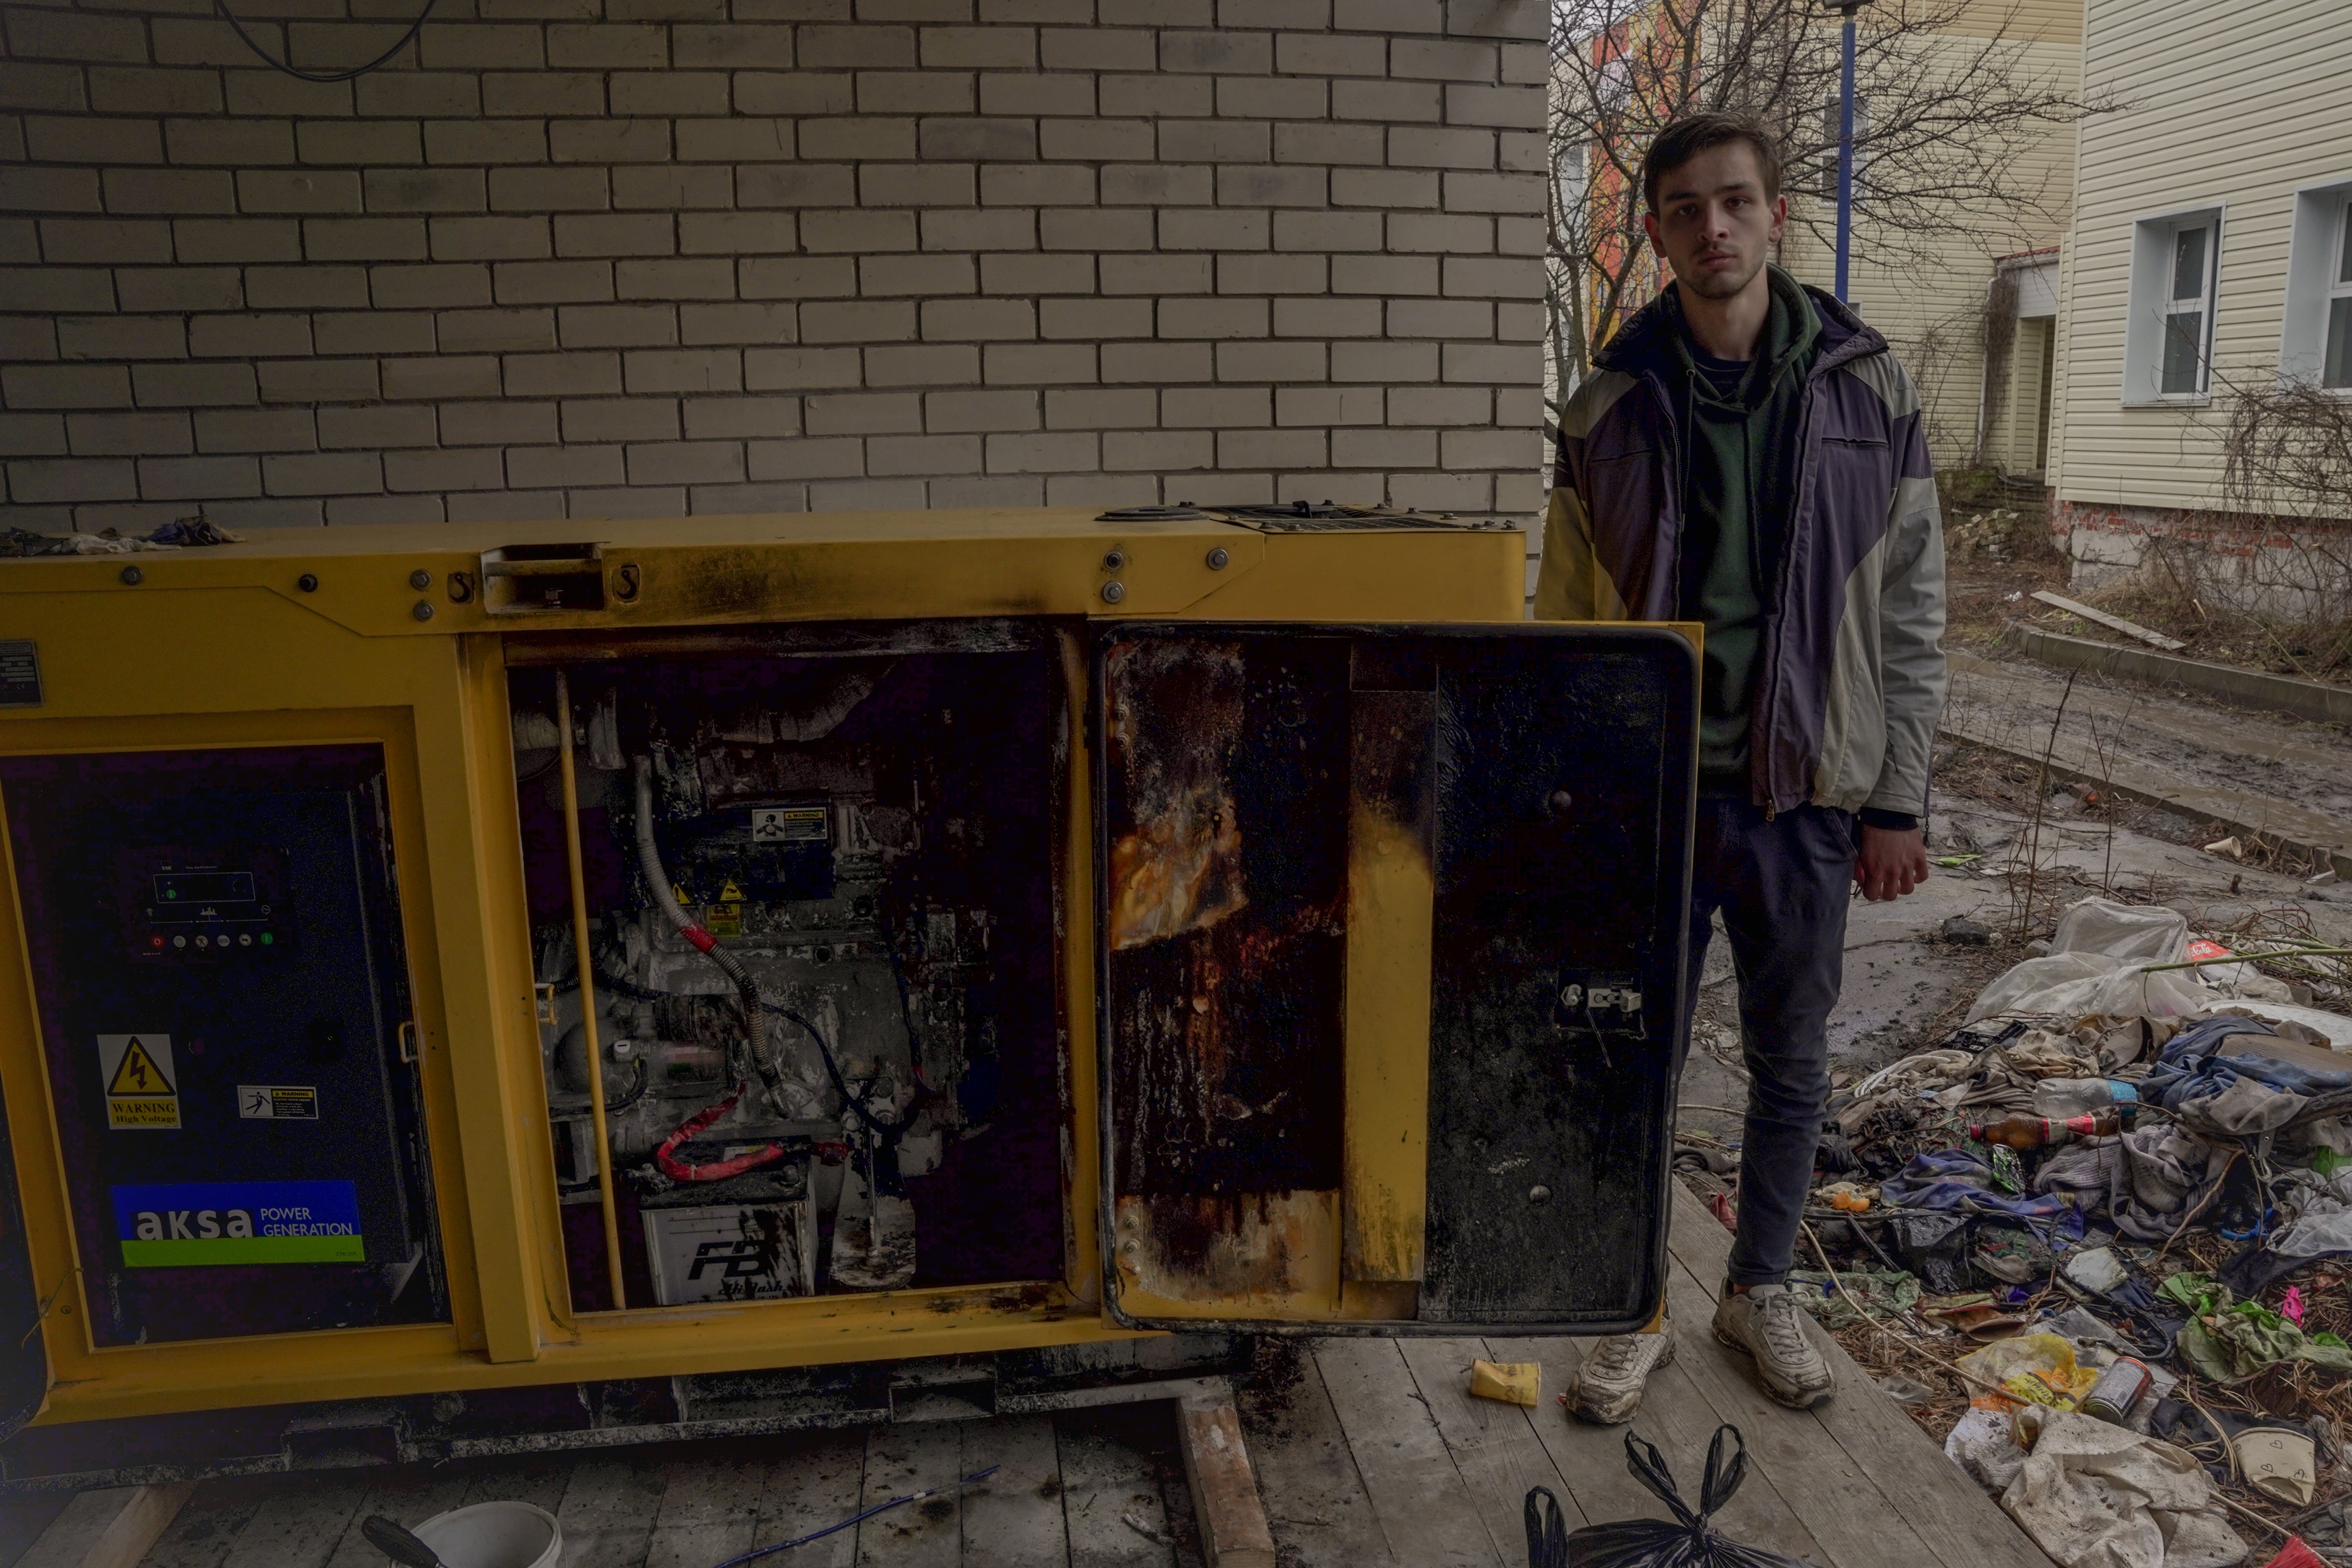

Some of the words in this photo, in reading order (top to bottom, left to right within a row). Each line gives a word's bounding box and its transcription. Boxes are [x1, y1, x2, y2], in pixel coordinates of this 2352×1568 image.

[112, 1103, 175, 1113] WARNING
[116, 1115, 139, 1124] High
[141, 1115, 176, 1123] Voltage
[260, 1207, 312, 1221] POWER
[137, 1209, 254, 1241] aksa
[263, 1222, 353, 1237] GENERATION
